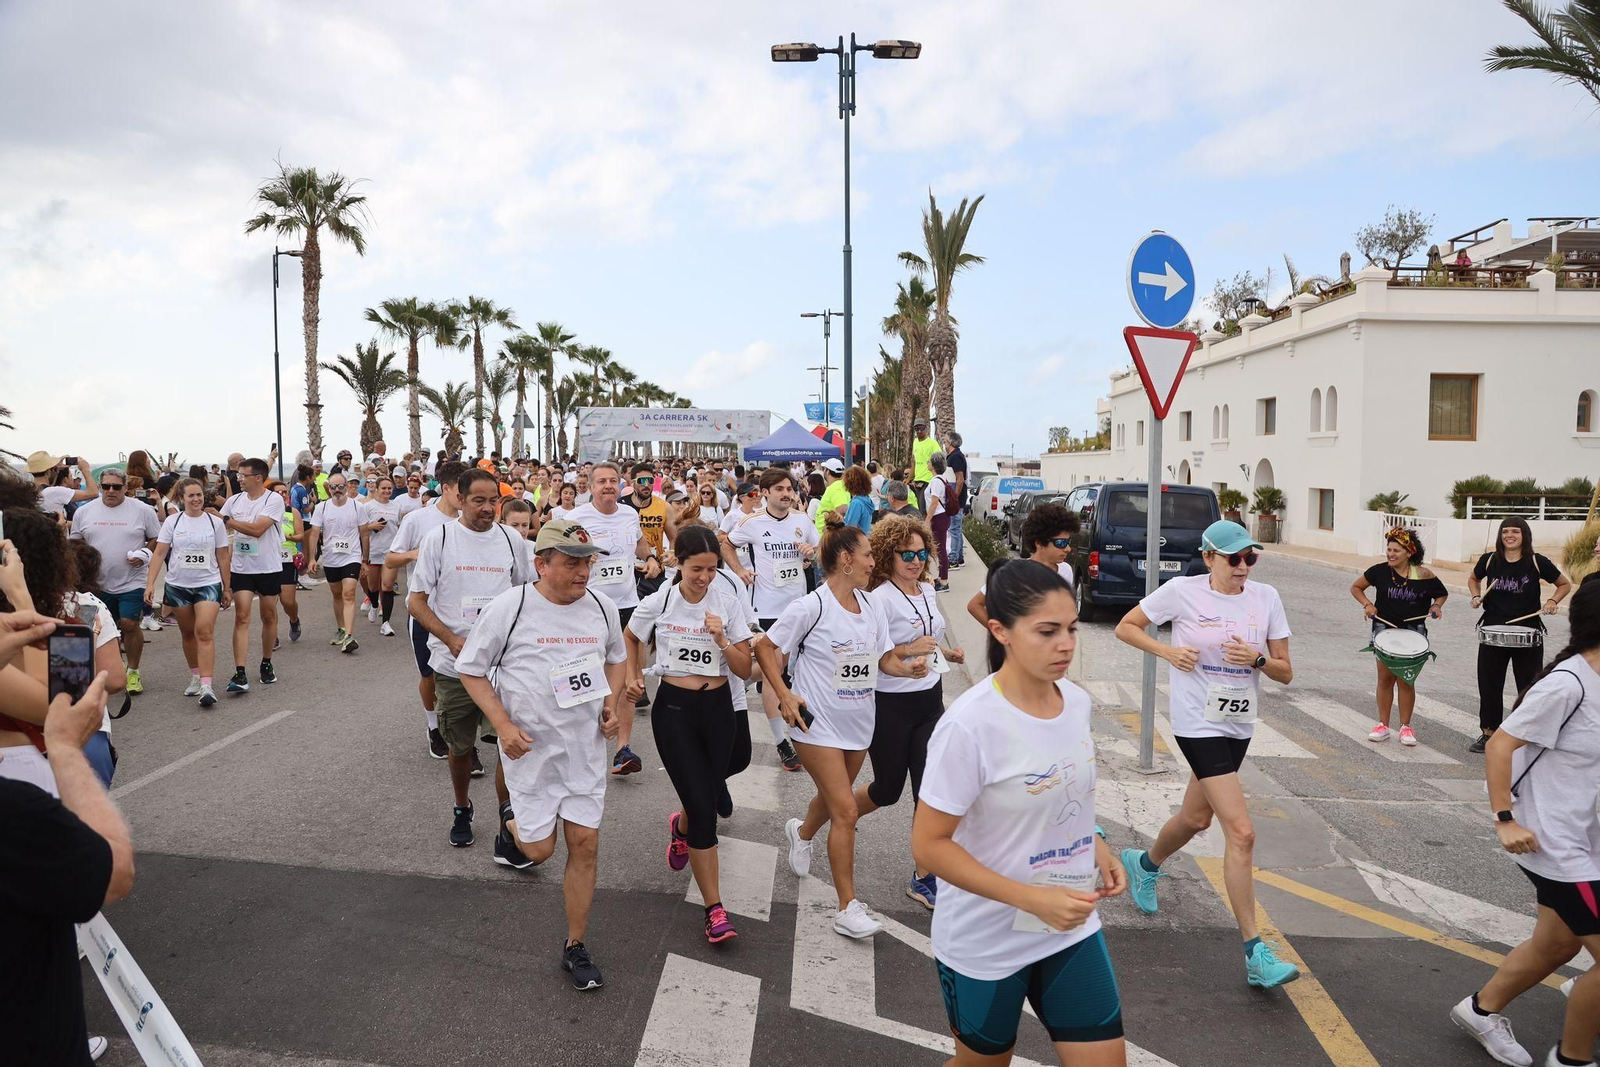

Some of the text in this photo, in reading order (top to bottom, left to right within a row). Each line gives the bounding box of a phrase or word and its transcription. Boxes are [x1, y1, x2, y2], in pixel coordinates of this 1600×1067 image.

[640, 514, 663, 522] hos
[240, 542, 250, 550] 23
[185, 555, 205, 563] 238
[772, 550, 799, 559] FLY BETTER
[600, 566, 624, 578] 375
[780, 568, 798, 579] 373
[678, 648, 712, 665] 296
[840, 664, 870, 678] 394
[568, 672, 592, 692] 56
[1218, 698, 1250, 713] 752
